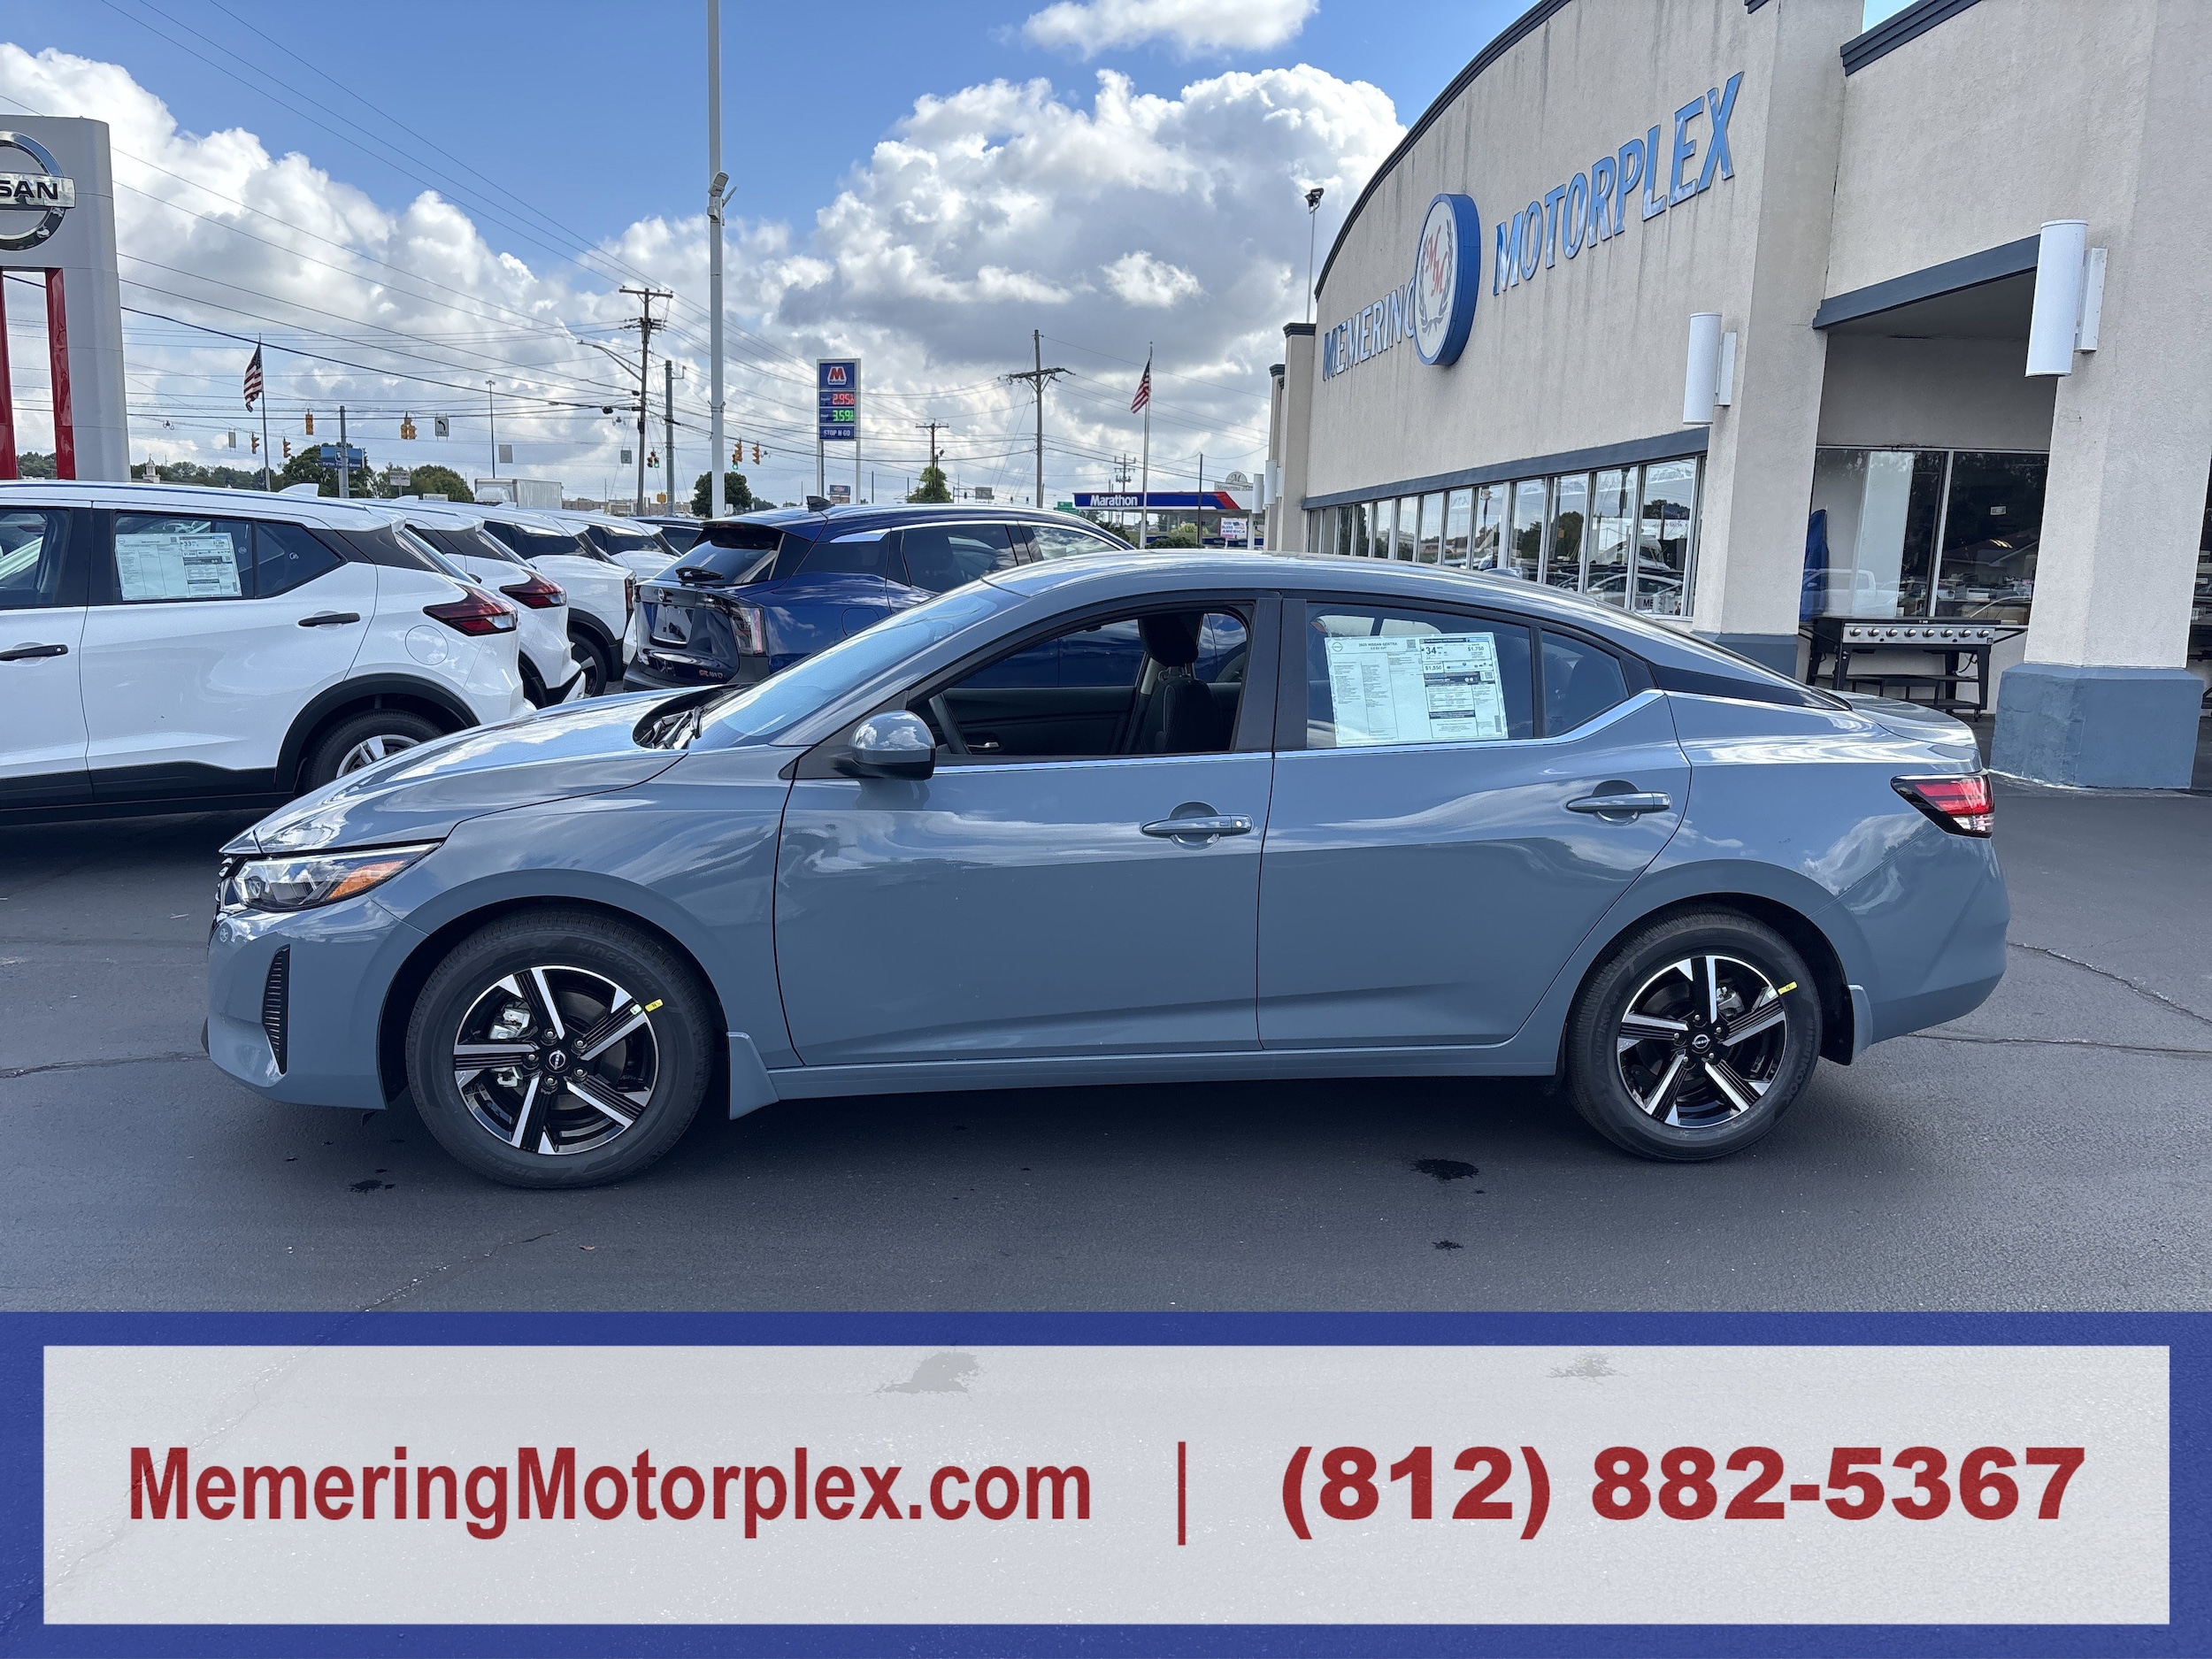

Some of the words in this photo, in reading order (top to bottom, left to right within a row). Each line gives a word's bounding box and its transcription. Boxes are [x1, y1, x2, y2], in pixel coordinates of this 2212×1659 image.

[1493, 71, 1744, 296] MOTORPLEX
[1090, 495, 1138, 506] Marathon
[1425, 646, 1437, 655] 34
